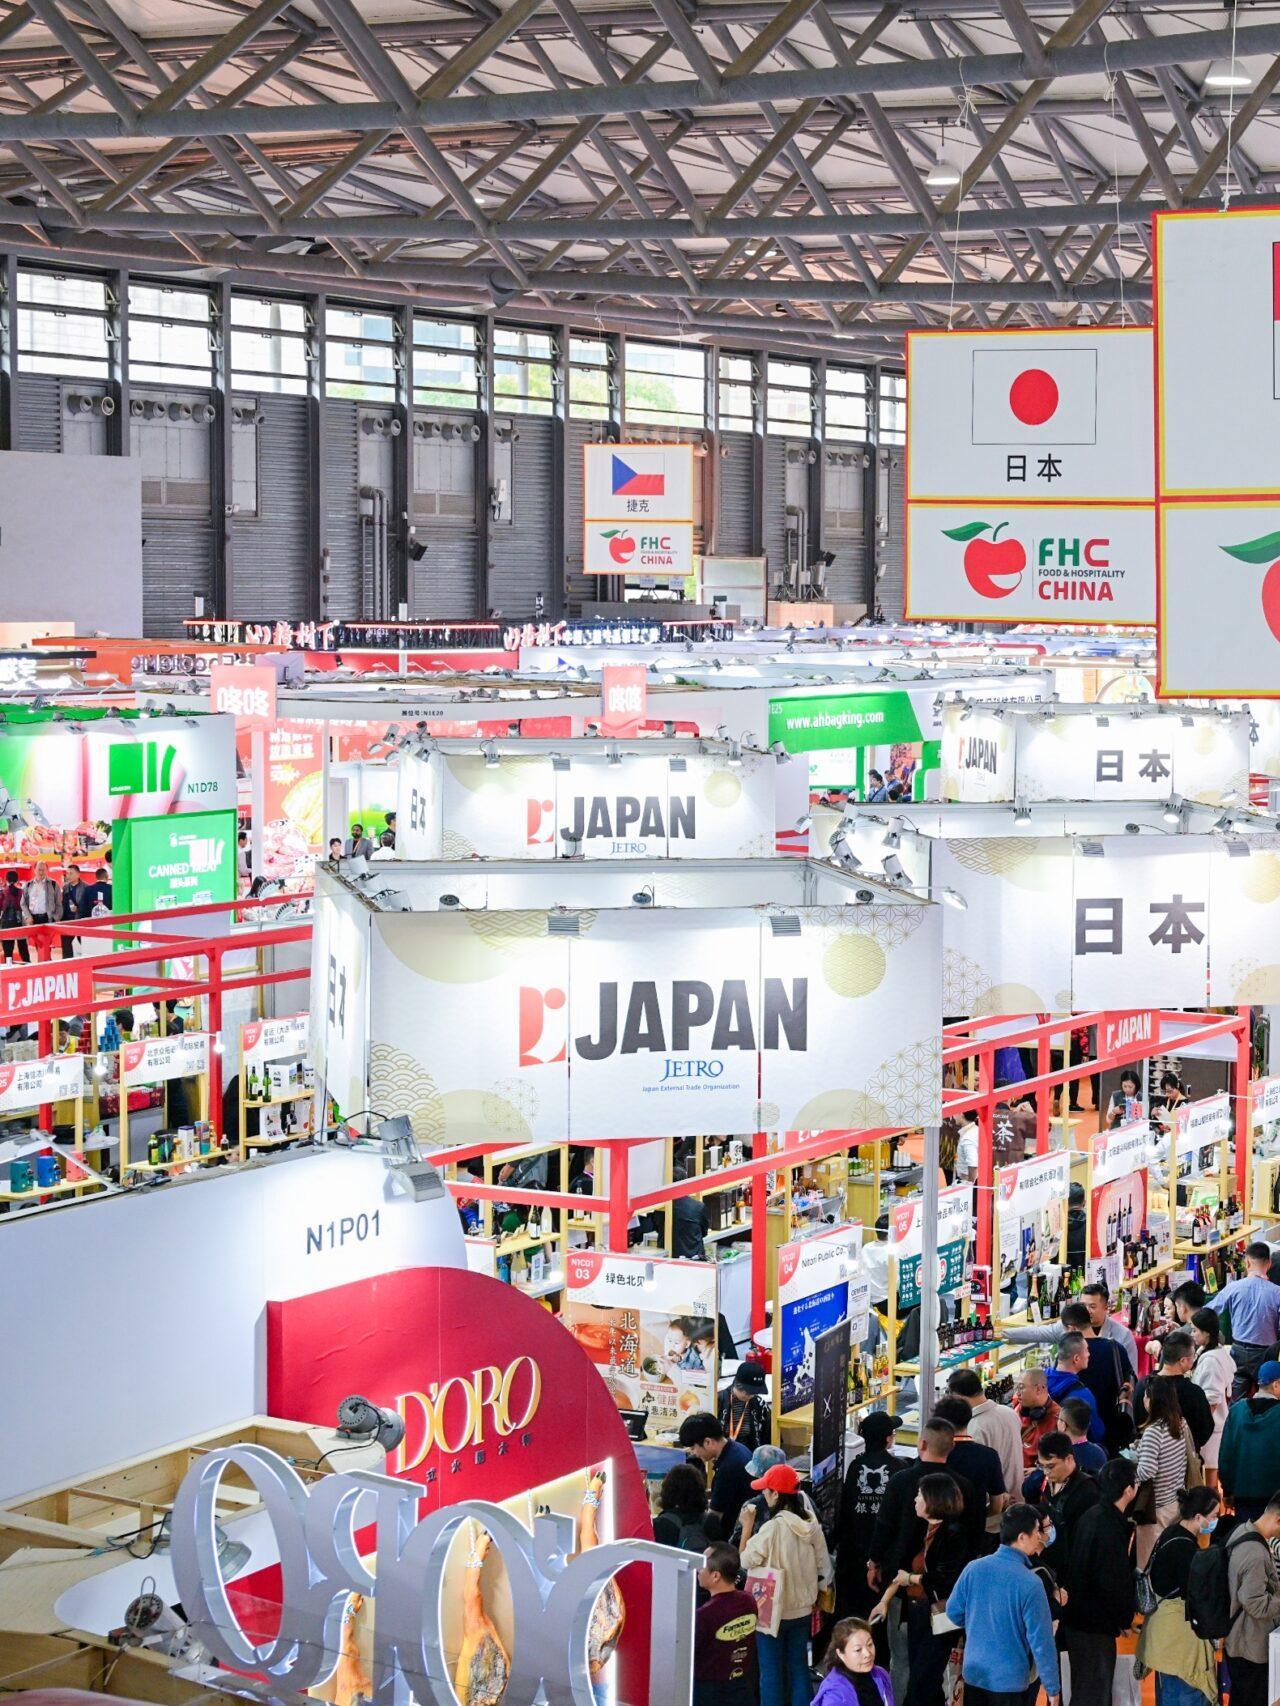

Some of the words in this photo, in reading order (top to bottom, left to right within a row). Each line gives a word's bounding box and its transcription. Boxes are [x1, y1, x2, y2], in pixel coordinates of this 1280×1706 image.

[1005, 453, 1064, 484] 日本
[627, 499, 650, 513] 捷克
[640, 537, 671, 550] FHC
[1038, 538, 1110, 566] FHC
[640, 555, 673, 565] CHINA
[1038, 569, 1061, 578] FOOD
[1063, 569, 1069, 578] &
[1071, 569, 1126, 579] HOSPITALITY
[1038, 580, 1114, 602] CHINA
[216, 686, 269, 717] 咚咚
[609, 684, 644, 714] 咚咚
[786, 710, 884, 731] www.ahbagking.com
[965, 736, 997, 775] JAPAN
[1096, 749, 1171, 783] 日本
[188, 782, 219, 794] N1D78
[560, 795, 696, 841] JAPAN
[611, 841, 648, 855] JETRO
[149, 864, 190, 880] CANNED
[1075, 893, 1206, 956] 日本
[22, 971, 79, 1003] JAPAN
[575, 977, 809, 1061] JAPAN
[1114, 1012, 1152, 1051] JAPAN
[658, 1058, 724, 1083] JETRO
[642, 1085, 661, 1093] Japan
[661, 1084, 684, 1092] External
[703, 1083, 740, 1091] Organization
[994, 1120, 1015, 1146] 茶
[305, 1209, 381, 1255] N1P01
[575, 1269, 590, 1280] 03
[619, 1311, 640, 1379] 北海道
[656, 1393, 678, 1406] 健康
[394, 1356, 543, 1475] D'ORO
